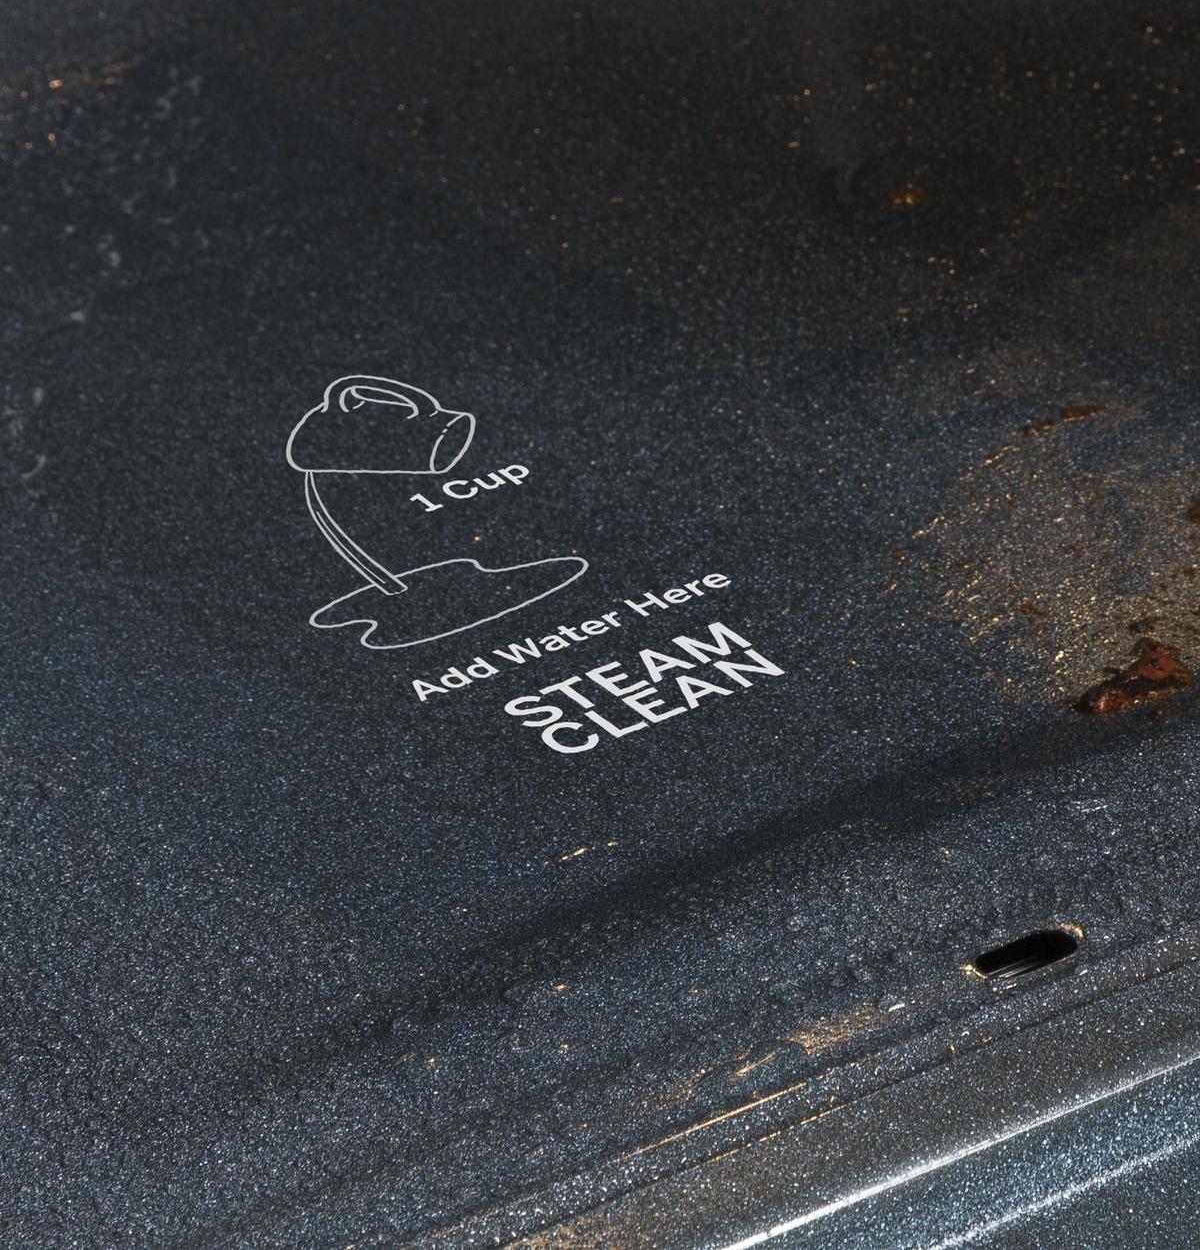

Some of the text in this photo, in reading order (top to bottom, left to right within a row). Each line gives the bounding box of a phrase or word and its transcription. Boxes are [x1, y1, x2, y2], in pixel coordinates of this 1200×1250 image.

[409, 461, 530, 512] 1 Cup
[411, 571, 732, 702] Add Water Here
[504, 622, 753, 728] STEAM
[541, 649, 785, 754] CLEAN
